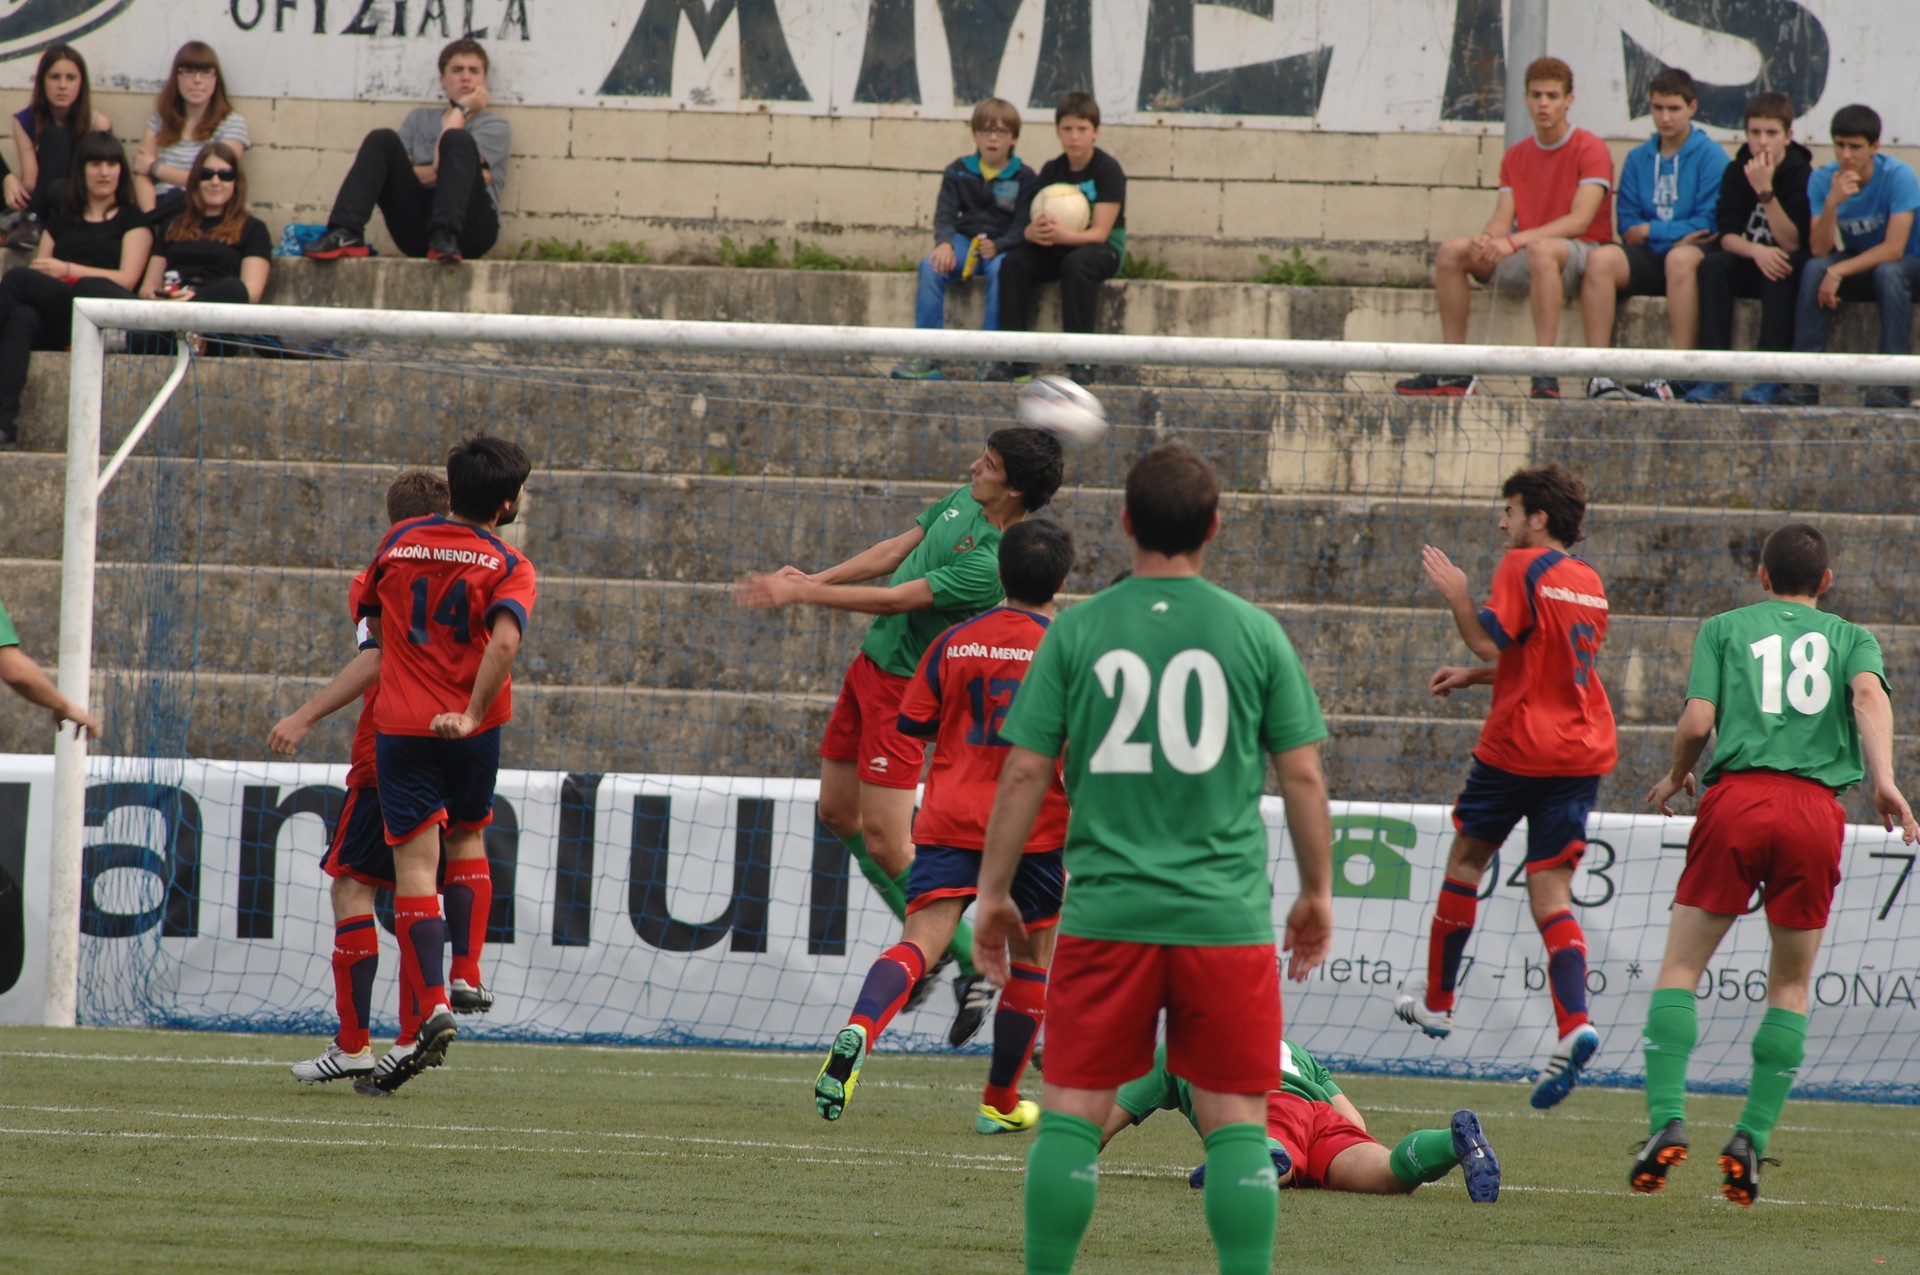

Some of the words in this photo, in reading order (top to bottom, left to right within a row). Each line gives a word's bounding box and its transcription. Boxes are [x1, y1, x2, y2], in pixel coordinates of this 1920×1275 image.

[388, 544, 431, 559] ALOÑA
[433, 548, 477, 564] MENDI
[407, 576, 474, 645] 14
[946, 642, 989, 659] ALOÑA
[989, 646, 1034, 662] MENDI
[1750, 631, 1832, 716] 18
[965, 676, 1022, 747] 12
[1089, 648, 1230, 775] 20
[1815, 964, 1920, 1010] OÑA
